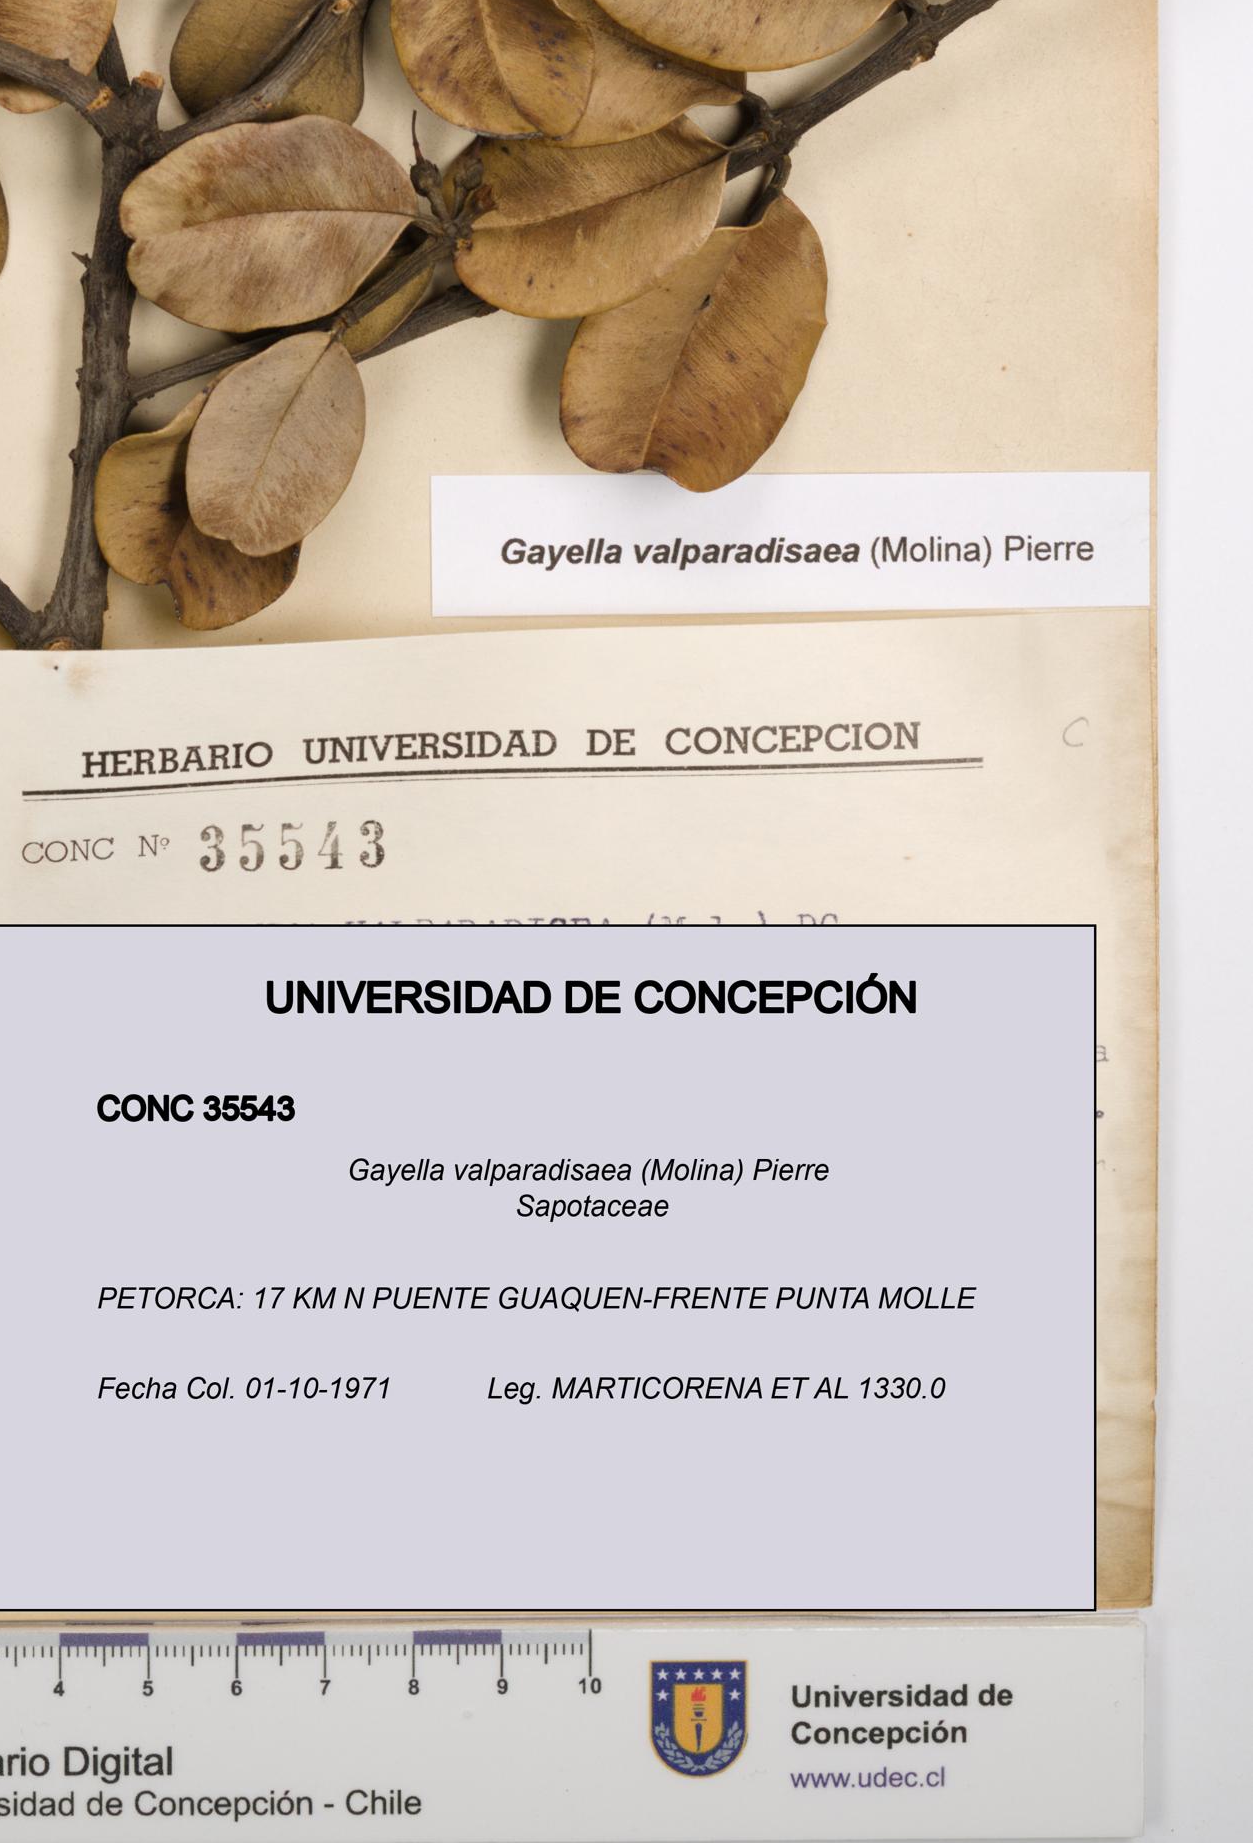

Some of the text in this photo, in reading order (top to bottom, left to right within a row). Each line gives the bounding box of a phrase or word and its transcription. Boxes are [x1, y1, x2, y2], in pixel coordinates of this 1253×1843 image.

[500, 534, 1094, 572] Gayella valparadisaea (Molina) Pierre
[81, 721, 921, 778] HERBARIO UNIVERSIDAD DE CONCEPCION
[20, 837, 115, 865] CONC
[199, 819, 386, 873] 35543
[53, 1680, 65, 1697] 4
[142, 1680, 154, 1697] 5
[230, 1679, 243, 1696] 6
[319, 1679, 332, 1696] 7
[408, 1678, 420, 1696] 8
[496, 1678, 509, 1695] 9
[578, 1677, 602, 1695] 10
[791, 1683, 1013, 1709] Universidad de
[791, 1718, 967, 1750] Concepción
[64, 1745, 173, 1785] Digital
[790, 1765, 946, 1789] www.udec.cl
[86, 1790, 123, 1817] de
[134, 1790, 313, 1824] Concepción
[345, 1789, 422, 1816] Chile
